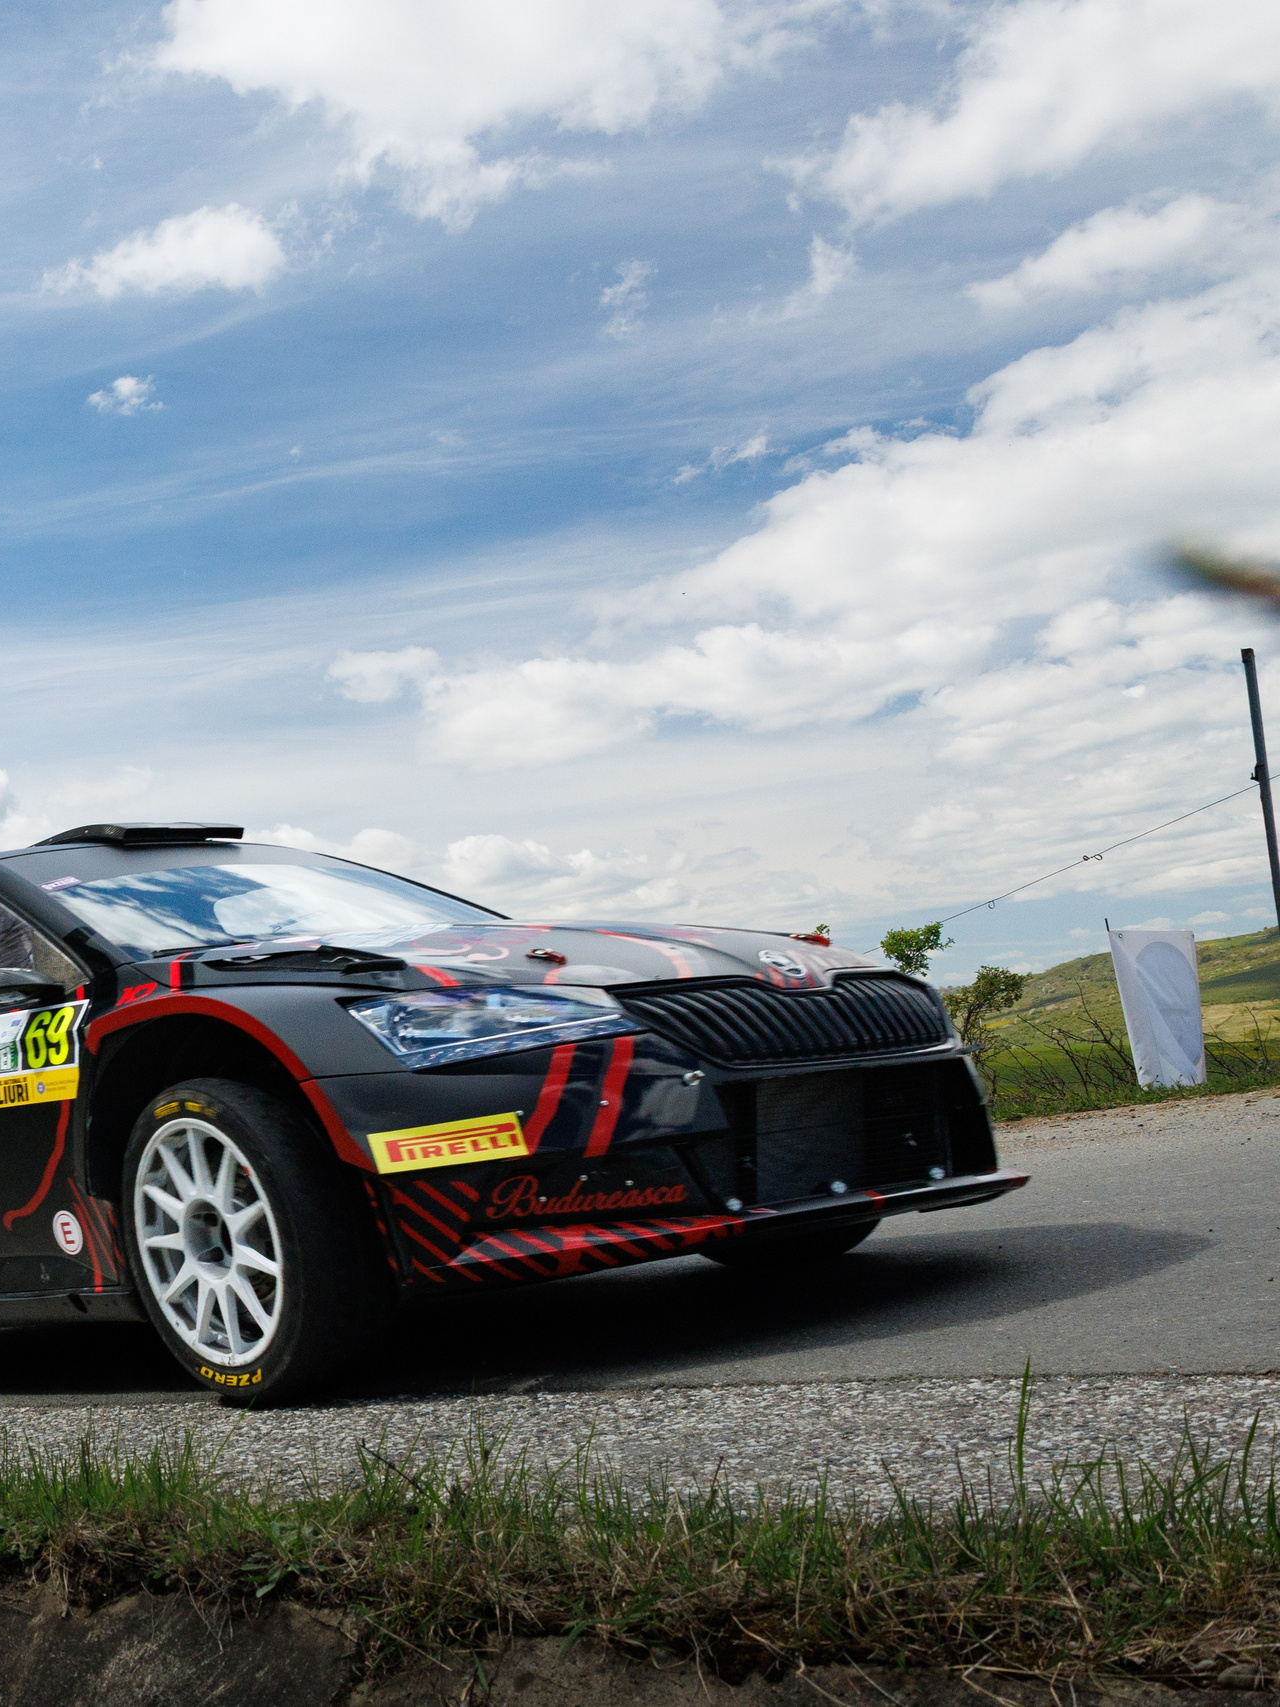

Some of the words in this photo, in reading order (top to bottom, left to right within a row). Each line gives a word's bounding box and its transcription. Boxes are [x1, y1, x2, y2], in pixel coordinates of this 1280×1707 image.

[24, 1006, 75, 1069] 69
[384, 1122, 521, 1163] PIRELLI
[485, 1175, 689, 1219] Budureasca
[60, 1222, 76, 1245] E
[200, 1366, 262, 1387] PZERO
